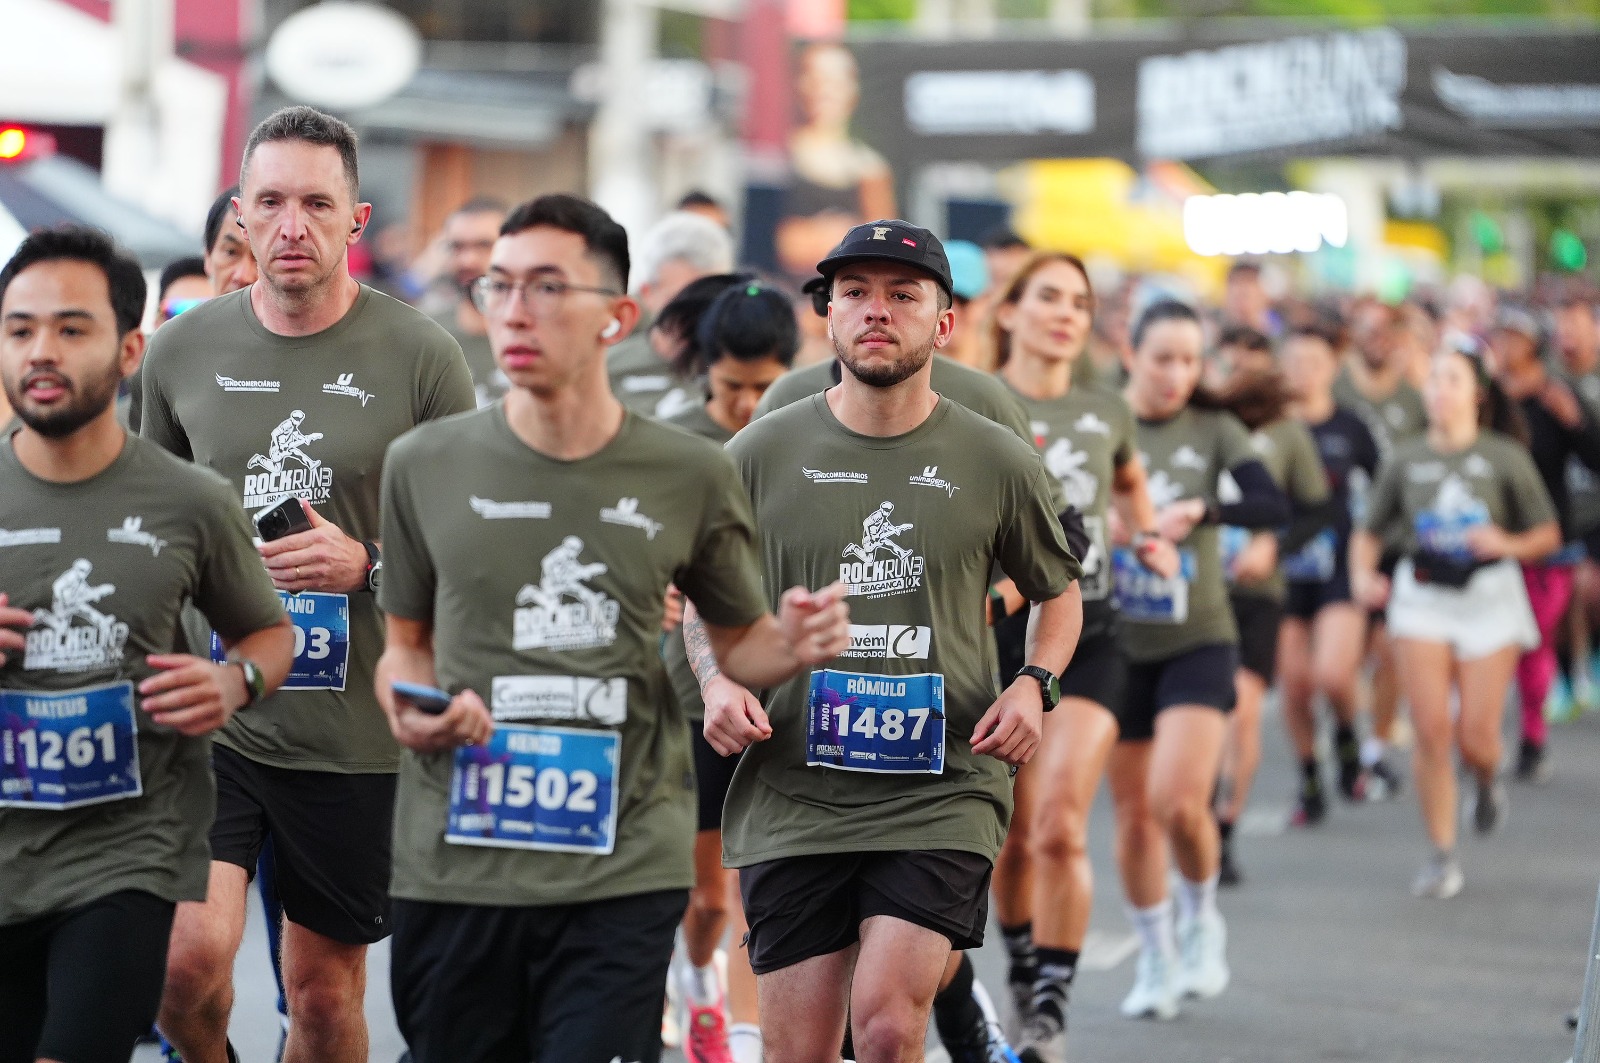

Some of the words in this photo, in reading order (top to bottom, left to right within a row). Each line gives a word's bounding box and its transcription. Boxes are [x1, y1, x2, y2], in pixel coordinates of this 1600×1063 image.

[224, 379, 281, 389] SINDCOMERCIÁRIOS
[322, 383, 361, 396] unimagem
[812, 470, 869, 480] SINDCOMERCIÁRIOS
[909, 475, 946, 486] unimagem
[280, 596, 315, 615] IANO
[292, 624, 331, 660] 03
[847, 677, 907, 698] RÔMULO
[821, 702, 830, 732] 10KM
[832, 704, 930, 741] 1487
[17, 722, 117, 771] 1261
[481, 762, 599, 813] 1502
